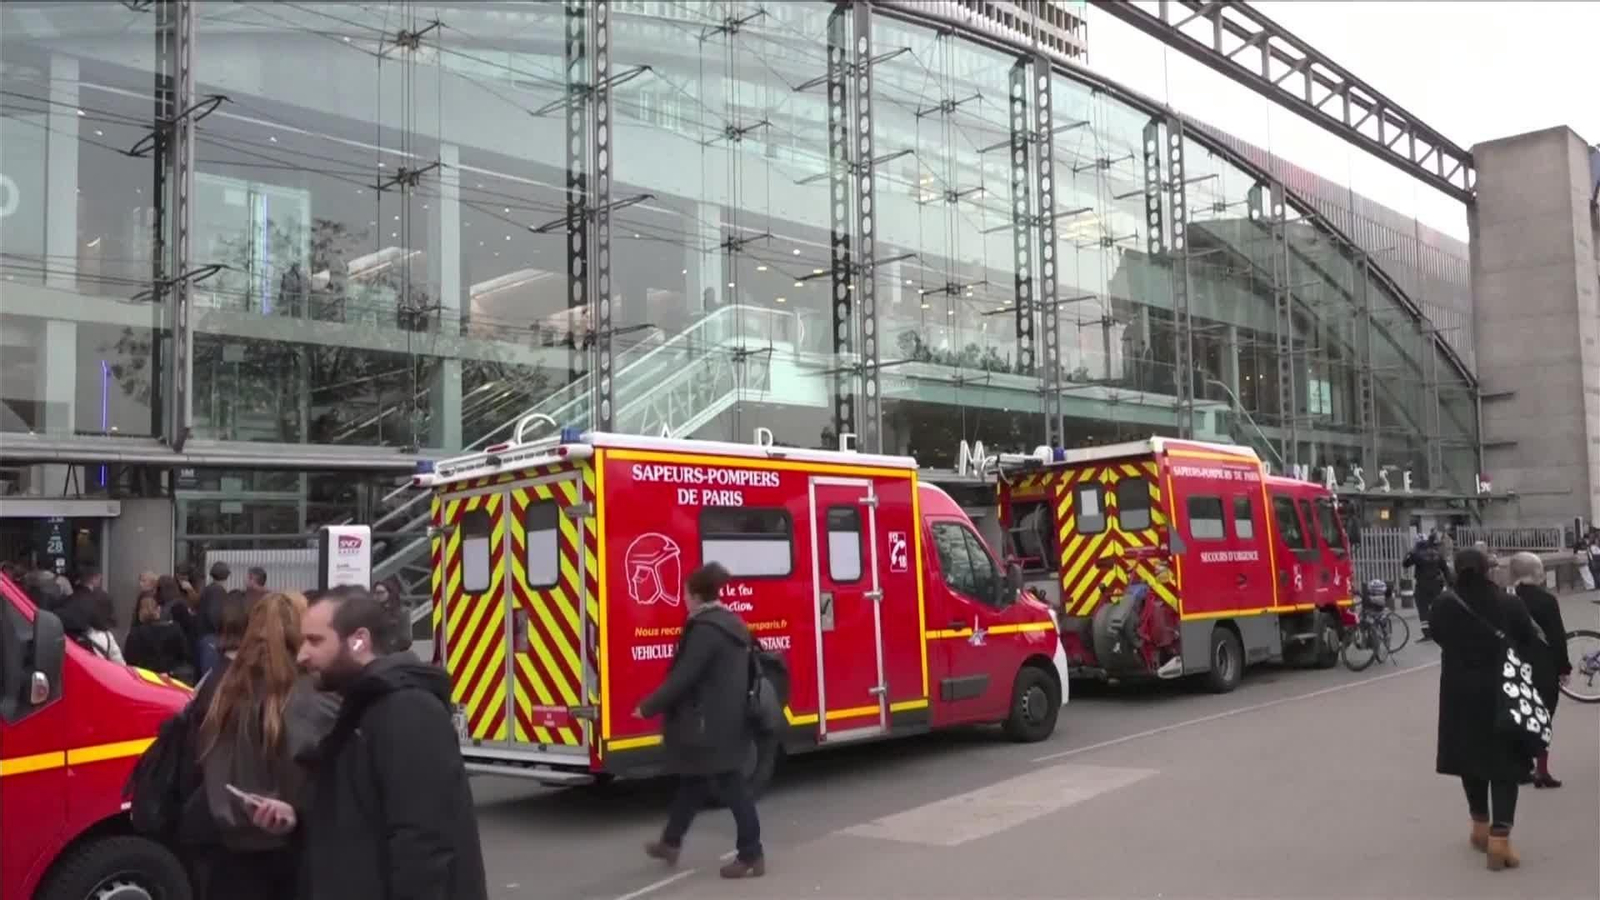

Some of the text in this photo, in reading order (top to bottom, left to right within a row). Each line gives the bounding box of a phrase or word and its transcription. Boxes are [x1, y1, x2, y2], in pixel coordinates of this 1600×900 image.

[632, 463, 780, 487] SAPEURS-POMPIERS
[677, 488, 743, 506] DE PARIS
[47, 541, 63, 554] 28
[726, 585, 736, 596] le
[738, 583, 753, 596] feu
[634, 627, 659, 637] Nous
[631, 643, 674, 660] VEHICULE
